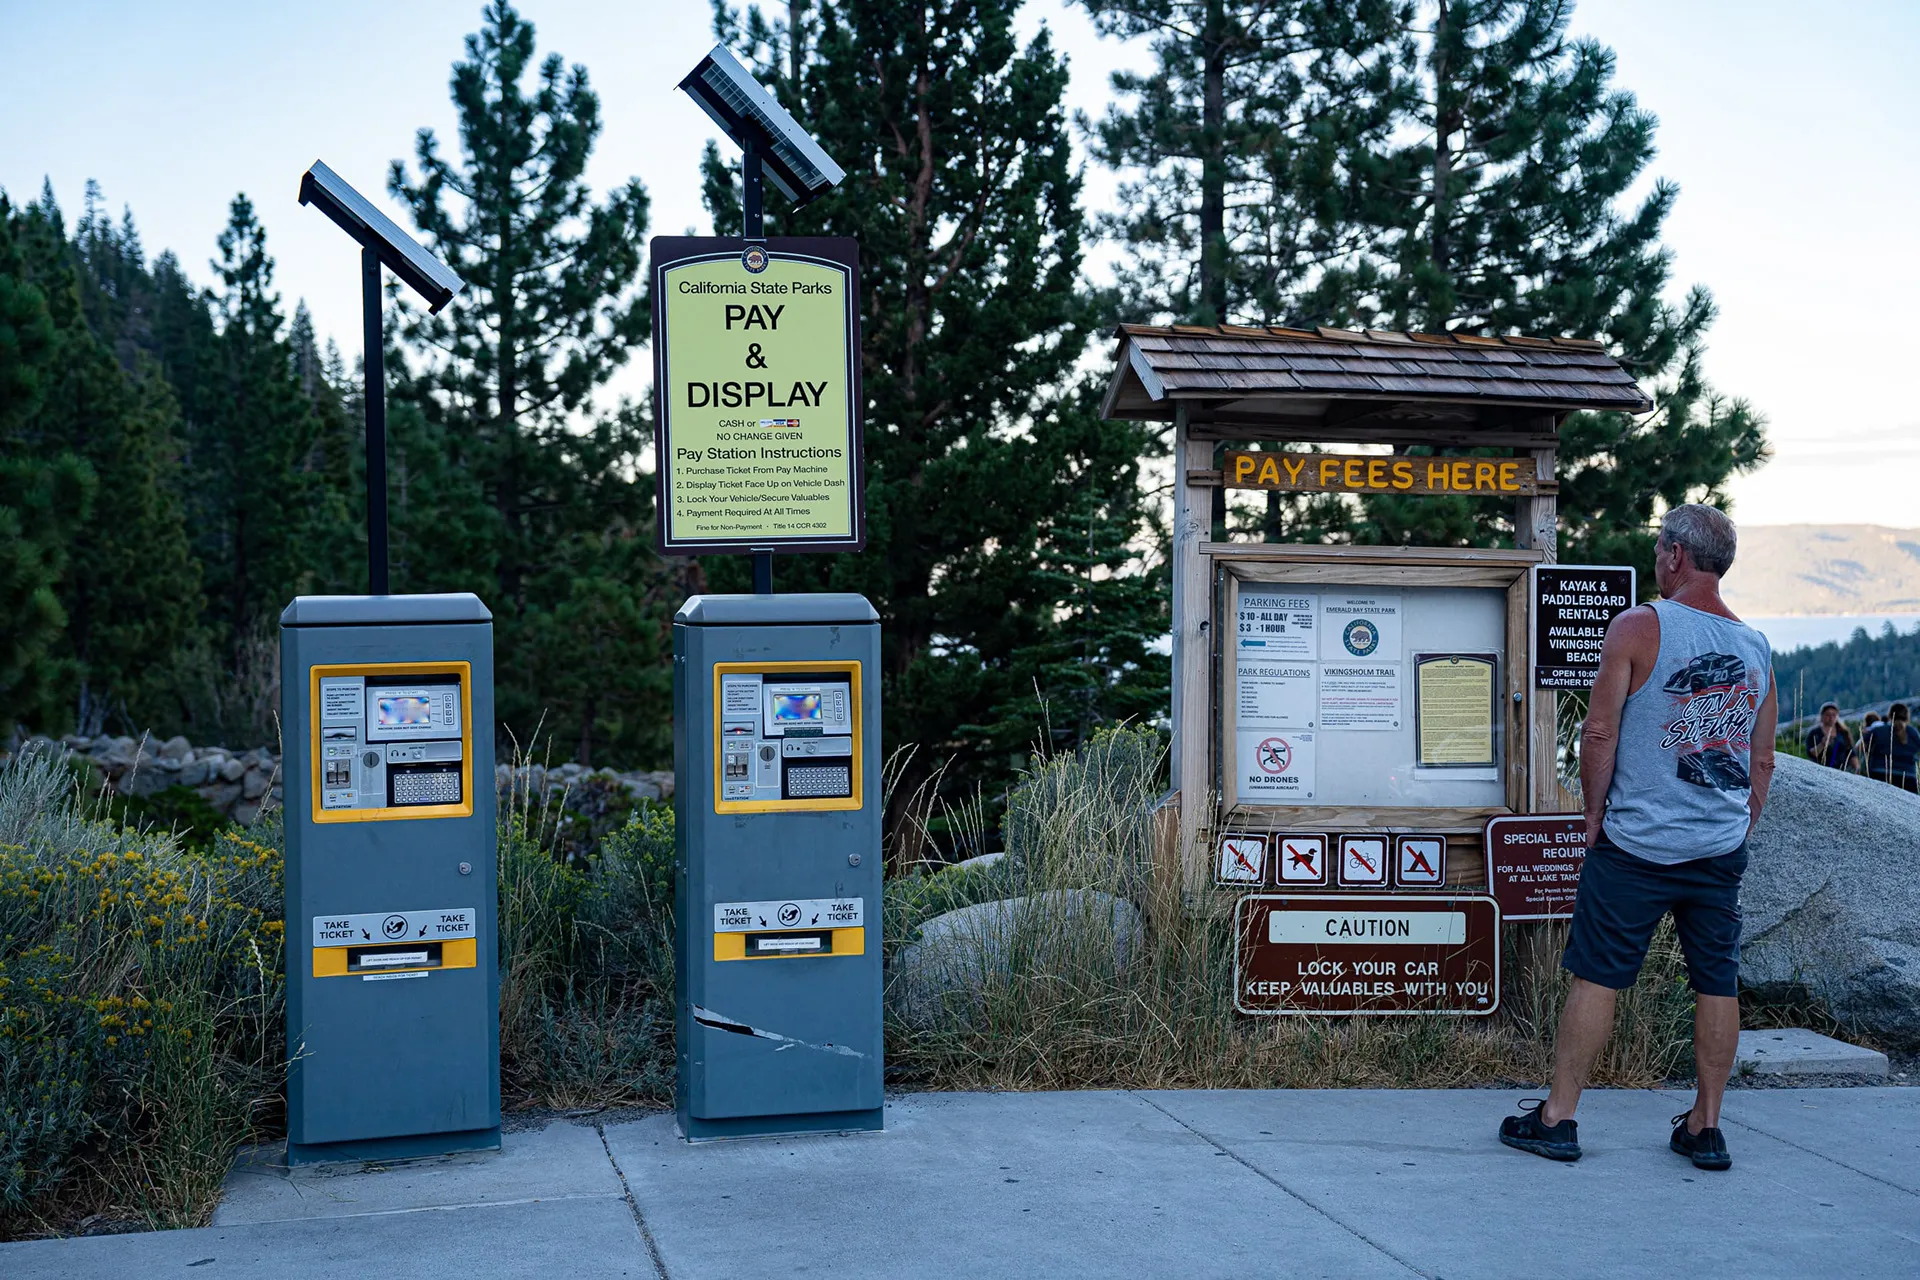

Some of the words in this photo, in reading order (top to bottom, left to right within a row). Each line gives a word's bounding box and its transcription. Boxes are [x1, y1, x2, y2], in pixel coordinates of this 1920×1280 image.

[679, 281, 747, 295] California
[750, 281, 788, 295] State
[792, 282, 832, 294] Parks
[725, 304, 785, 330] PAY
[745, 343, 768, 369] &
[687, 381, 828, 408] DISPLAY
[719, 420, 745, 428] CASH
[716, 433, 731, 441] NO
[733, 433, 772, 441] CHANGE
[775, 432, 803, 440] GIVEN
[677, 448, 703, 462] Pay
[707, 447, 756, 460] Station
[761, 447, 842, 459] Instructions
[686, 467, 724, 475] Purchase
[776, 466, 790, 476] Pay
[1235, 456, 1306, 485] PAY
[1319, 459, 1414, 490] FEES
[1427, 462, 1521, 491] HERE
[686, 481, 717, 490] Display
[745, 480, 765, 488] Face
[767, 480, 779, 489] Up
[793, 479, 822, 487] Vehicle
[824, 479, 845, 487] Dash
[687, 495, 707, 503] Lock
[730, 494, 789, 502] Vehicle/Secure
[687, 510, 723, 518] Payment
[725, 508, 762, 518] Required
[720, 524, 762, 532] Non-Payment
[1560, 580, 1597, 592] KAYAK
[1600, 581, 1608, 592] &
[1244, 598, 1286, 608] PARKING
[1288, 599, 1310, 609] FEES
[1542, 594, 1626, 606] PADDLEBOARD
[1260, 612, 1272, 621] ALL
[1274, 613, 1288, 621] DAY
[1558, 608, 1609, 620] RENTALS
[1265, 624, 1286, 633] HOUR
[1549, 627, 1604, 637] AVAILABLE
[1549, 639, 1603, 649] VIKINGSHO
[1566, 652, 1601, 662] BEACH
[1259, 668, 1311, 677] REGULATIONS
[1552, 670, 1575, 678] OPEN
[1578, 670, 1598, 678] 10:00
[1713, 669, 1728, 682] 20
[1540, 678, 1581, 686] WEATHER
[1504, 833, 1551, 845] SPECIAL
[1543, 848, 1586, 858] REQUIR
[1497, 865, 1513, 873] FOR
[1516, 865, 1530, 873] ALL
[1532, 864, 1574, 872] WEDDINGS
[1508, 875, 1518, 883] AT
[1537, 874, 1558, 882] LAKE
[1560, 873, 1580, 881] TAHO
[724, 908, 748, 916] TAKE
[831, 903, 854, 912] TAKE
[440, 914, 465, 923] TAKE
[720, 917, 752, 925] TICKET
[827, 912, 858, 921] TICKET
[324, 920, 350, 930] TAKE
[436, 923, 470, 933] TICKET
[1326, 919, 1410, 937] CAUTION
[319, 930, 354, 939] TICKET
[1298, 961, 1344, 976] LOCK
[1352, 961, 1396, 976] YOUR
[1404, 961, 1439, 976] CAR
[1246, 982, 1291, 996] KEEP
[1301, 981, 1395, 996] VALUABLES
[1404, 981, 1446, 996] WITH
[1455, 982, 1488, 996] YOU
